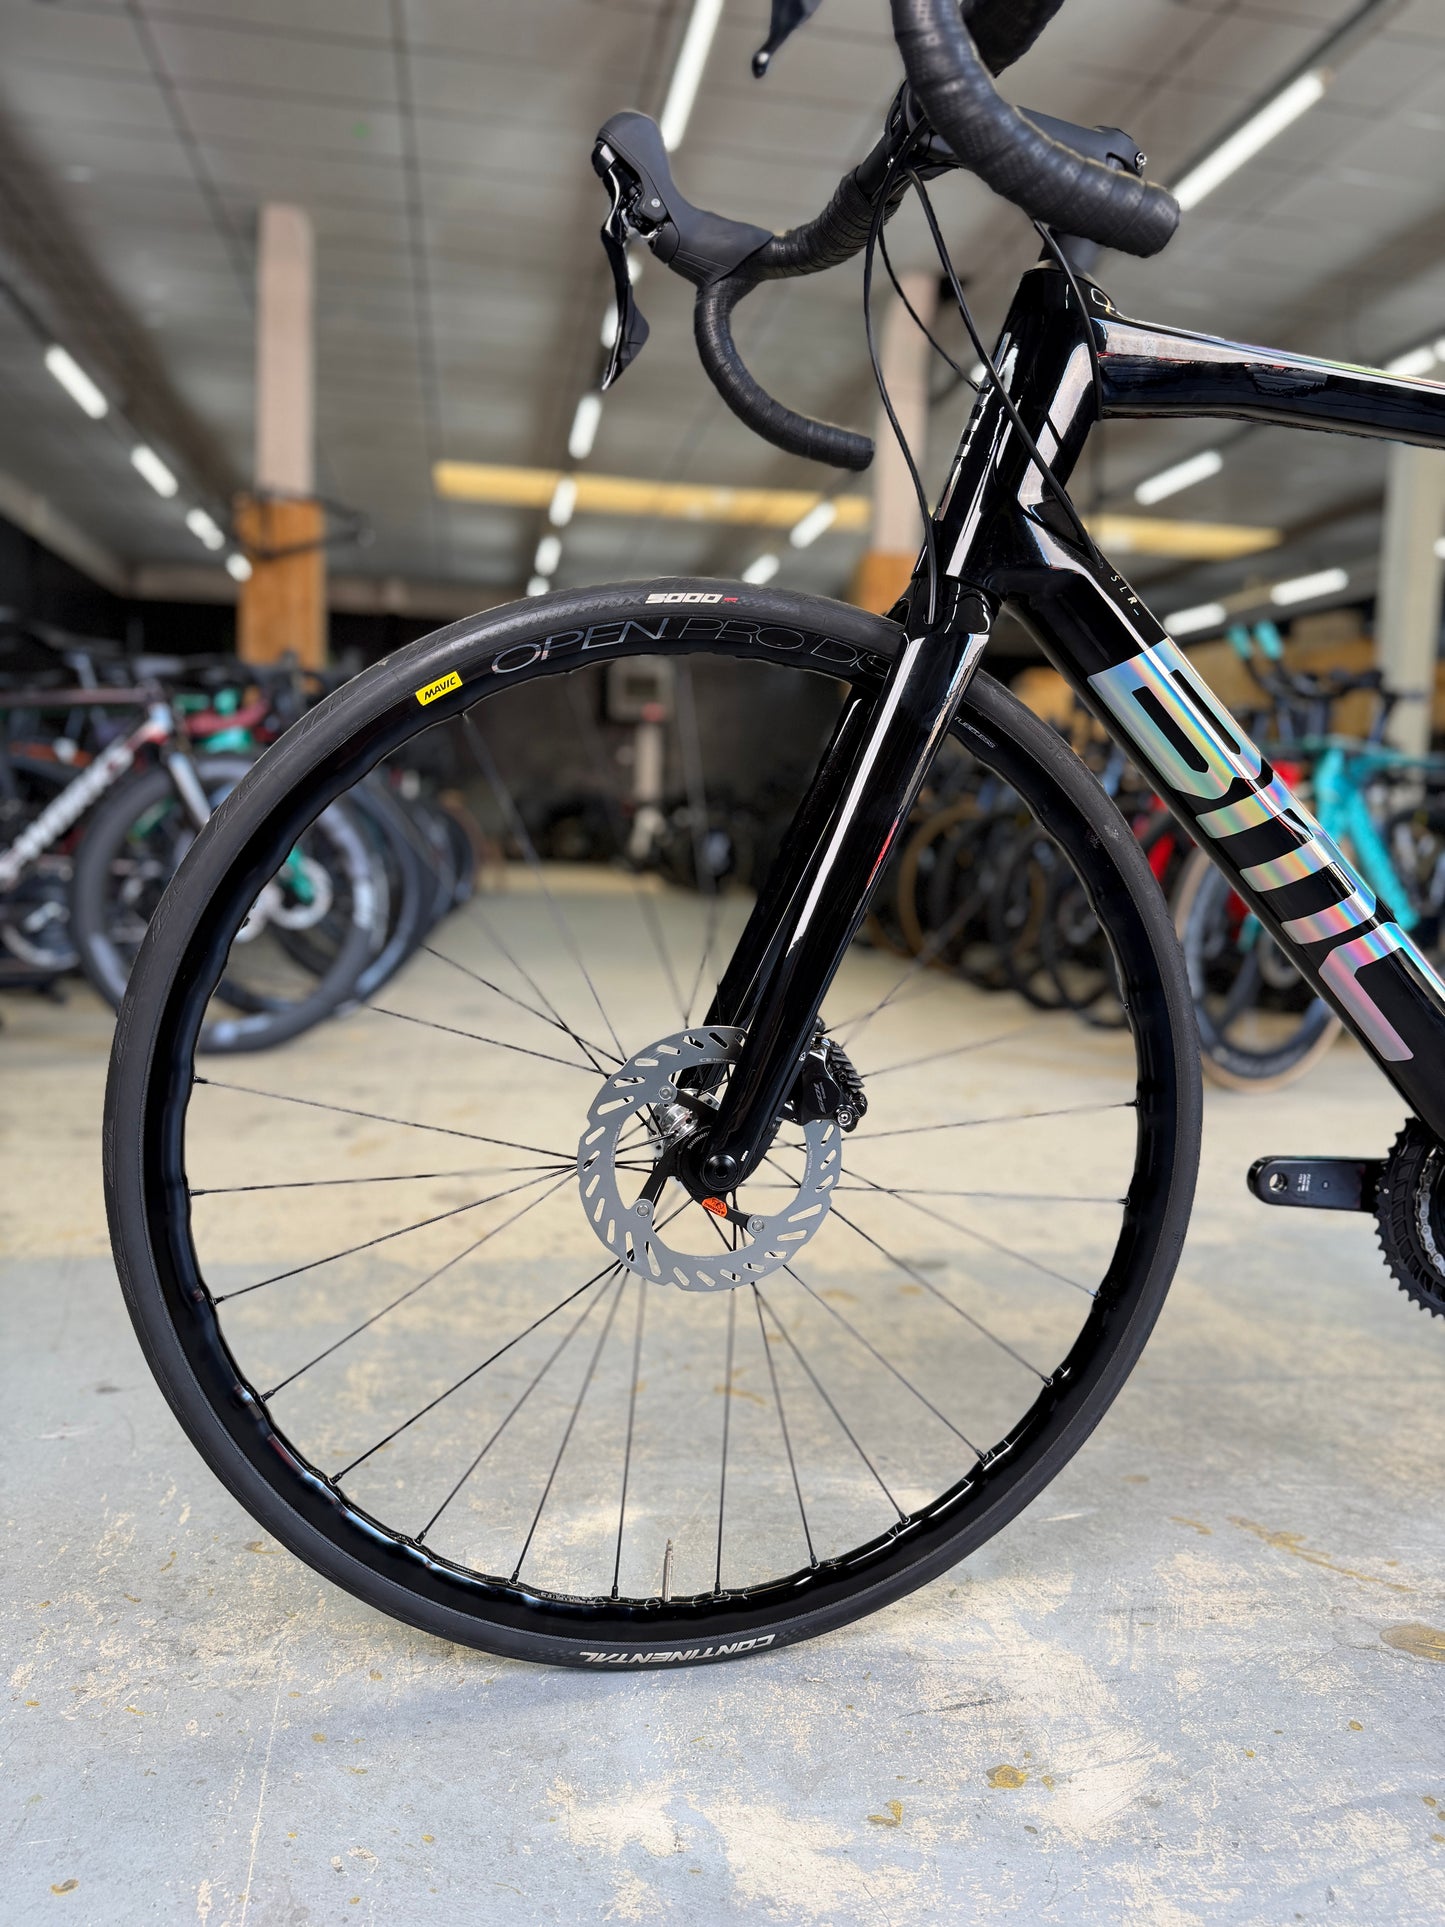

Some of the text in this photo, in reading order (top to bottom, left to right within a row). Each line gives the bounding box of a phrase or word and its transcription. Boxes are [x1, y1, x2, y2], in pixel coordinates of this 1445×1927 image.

[645, 592, 723, 604] 5000
[491, 617, 893, 680] OPEN PRO DIS
[423, 676, 457, 701] MAVIC
[580, 1633, 776, 1663] CONTINENTAL
